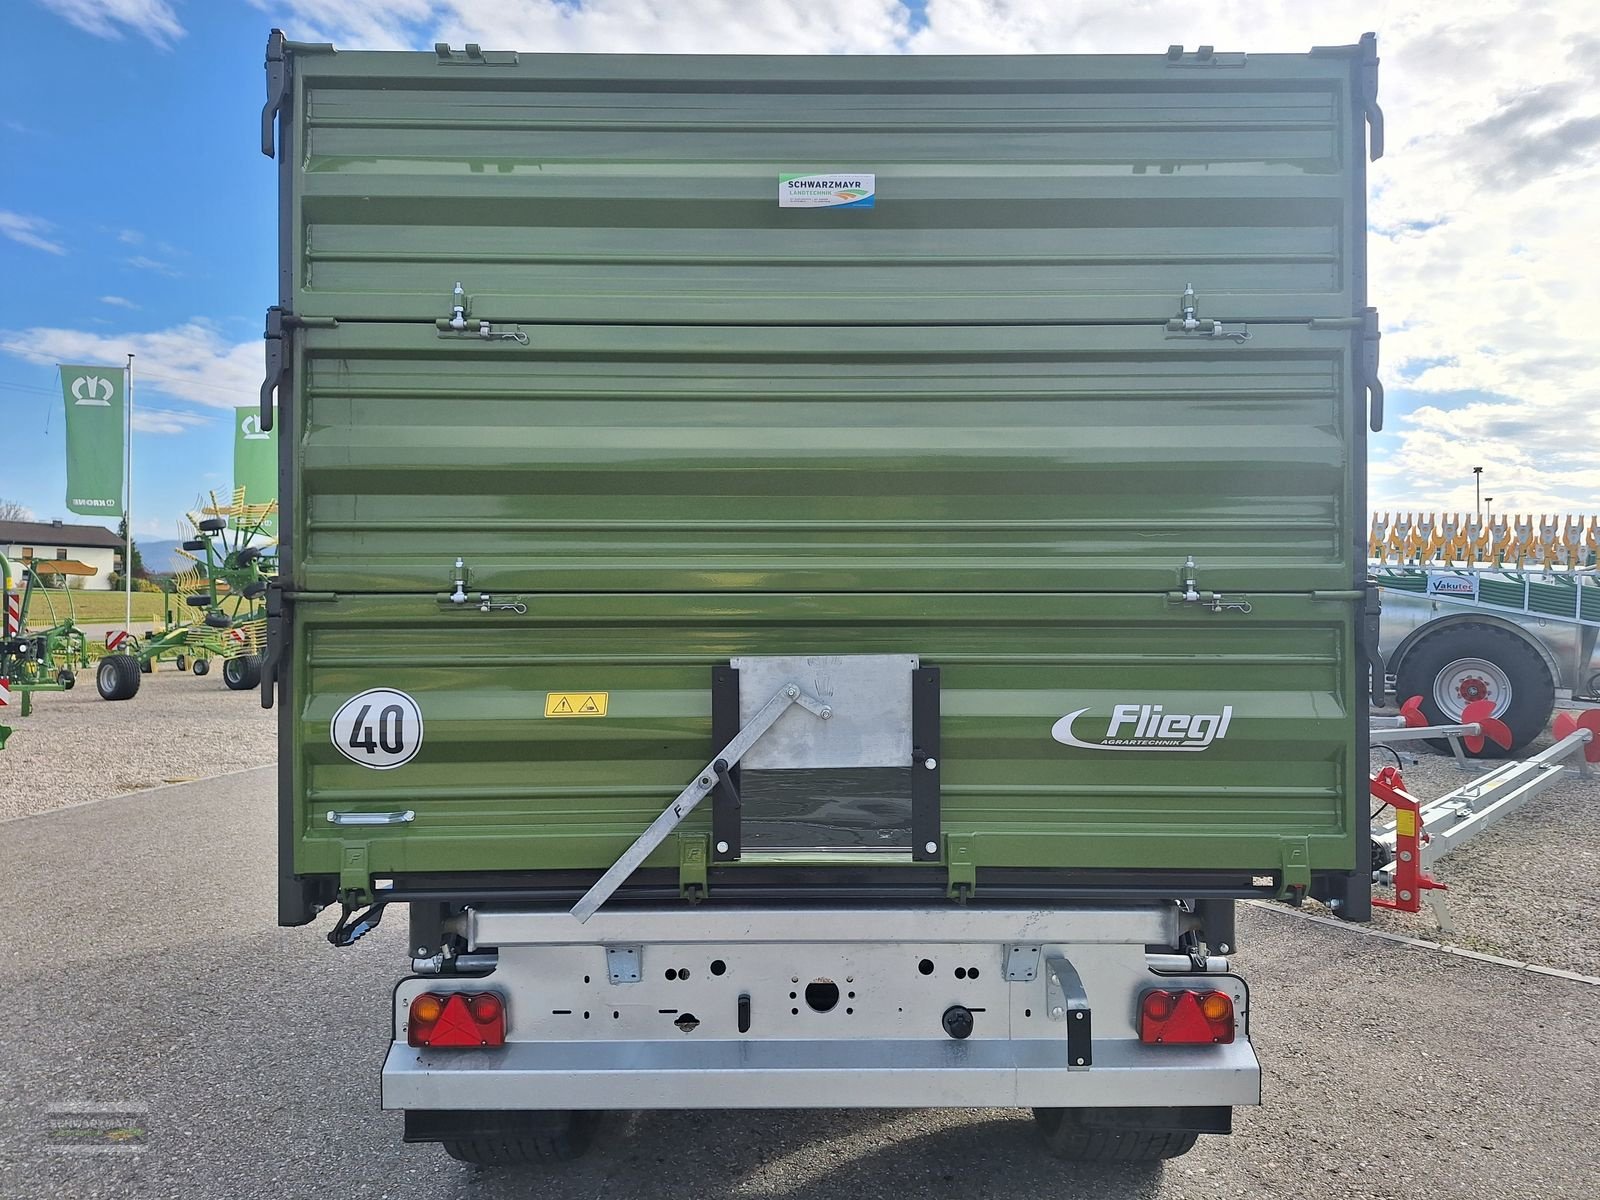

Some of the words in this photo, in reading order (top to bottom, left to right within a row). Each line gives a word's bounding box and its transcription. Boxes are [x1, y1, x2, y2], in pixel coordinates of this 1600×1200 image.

[788, 180, 862, 189] SCHWARZMAYR
[349, 704, 404, 754] 40
[1105, 704, 1233, 746] Fliegl
[1100, 739, 1182, 747] AGRARTECHNIK
[673, 803, 682, 819] F
